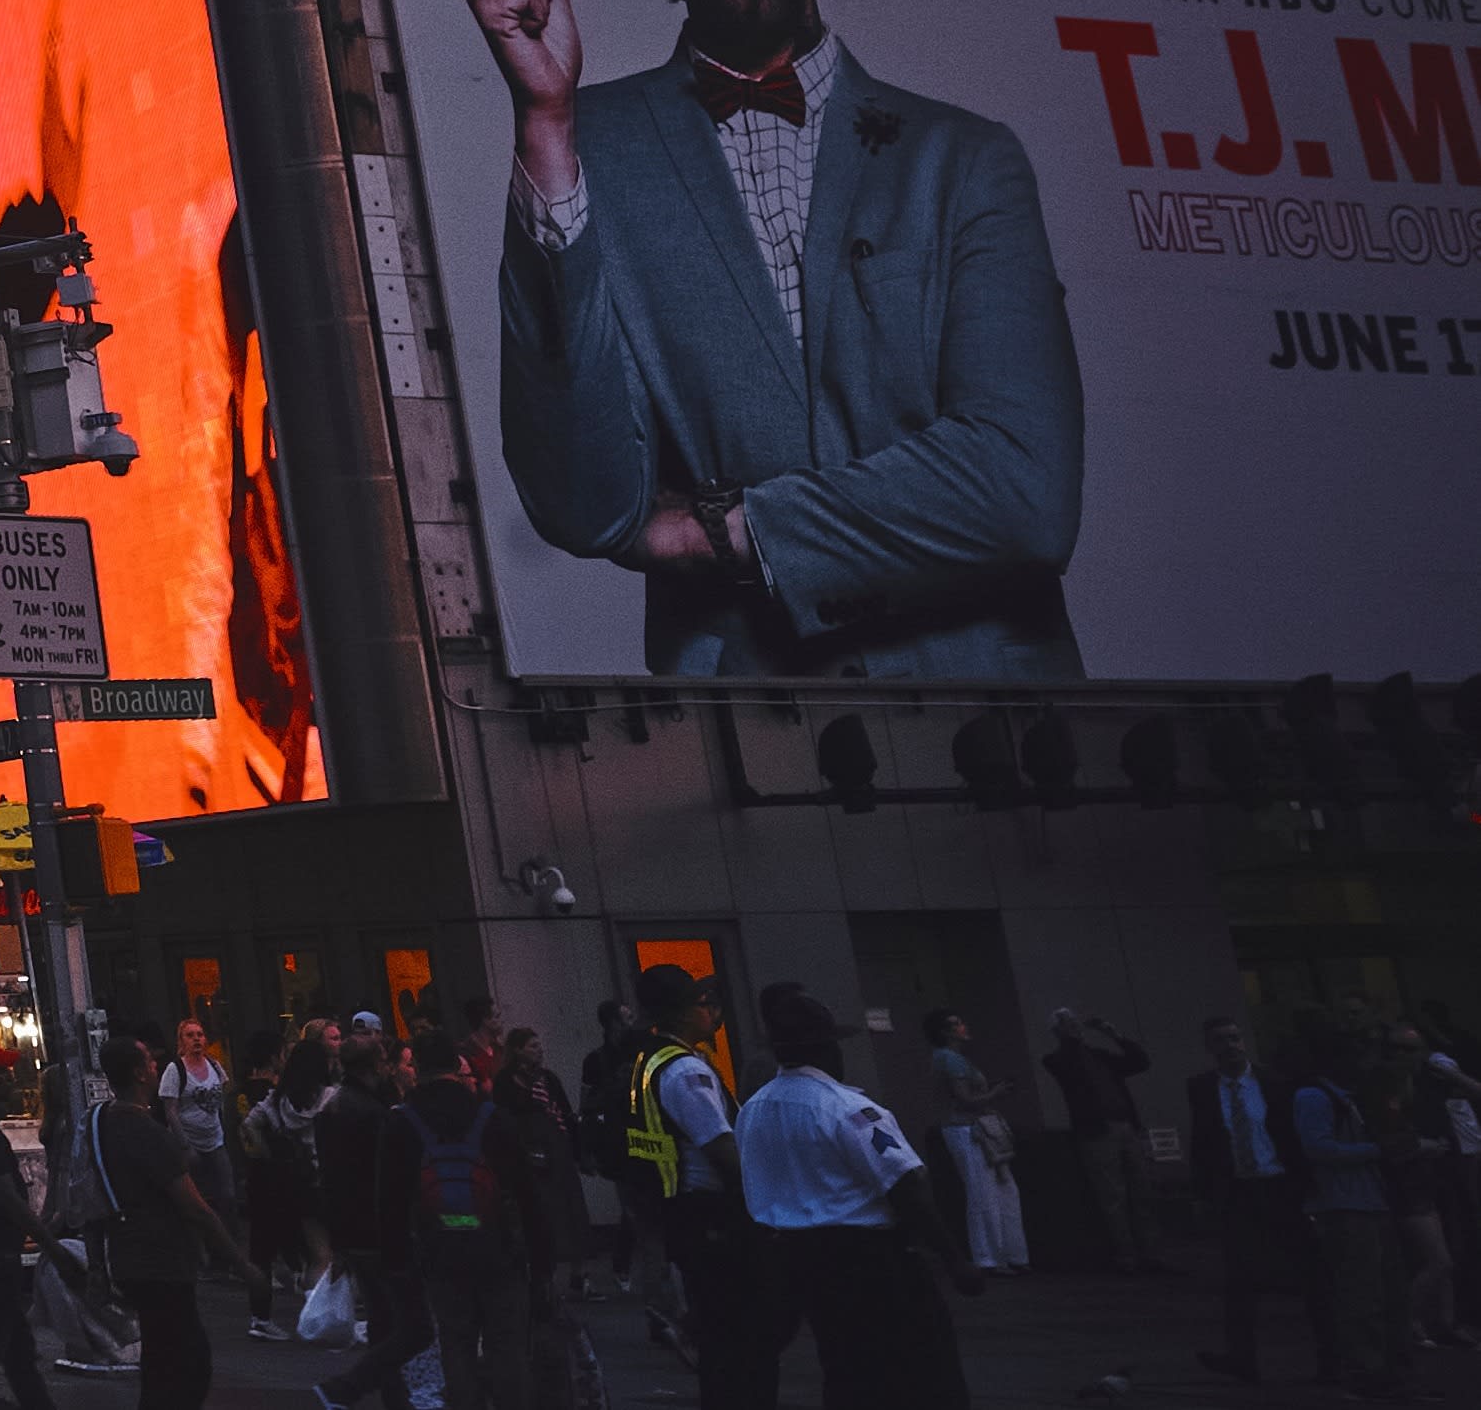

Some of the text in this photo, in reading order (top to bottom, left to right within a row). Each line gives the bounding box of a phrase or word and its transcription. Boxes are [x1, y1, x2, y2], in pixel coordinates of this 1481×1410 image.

[1054, 16, 1334, 177] T.J.
[1268, 308, 1429, 375] JUNE
[2, 566, 61, 592] ONLY
[12, 646, 99, 665] MON THRU FRI
[90, 686, 206, 717] Broadway
